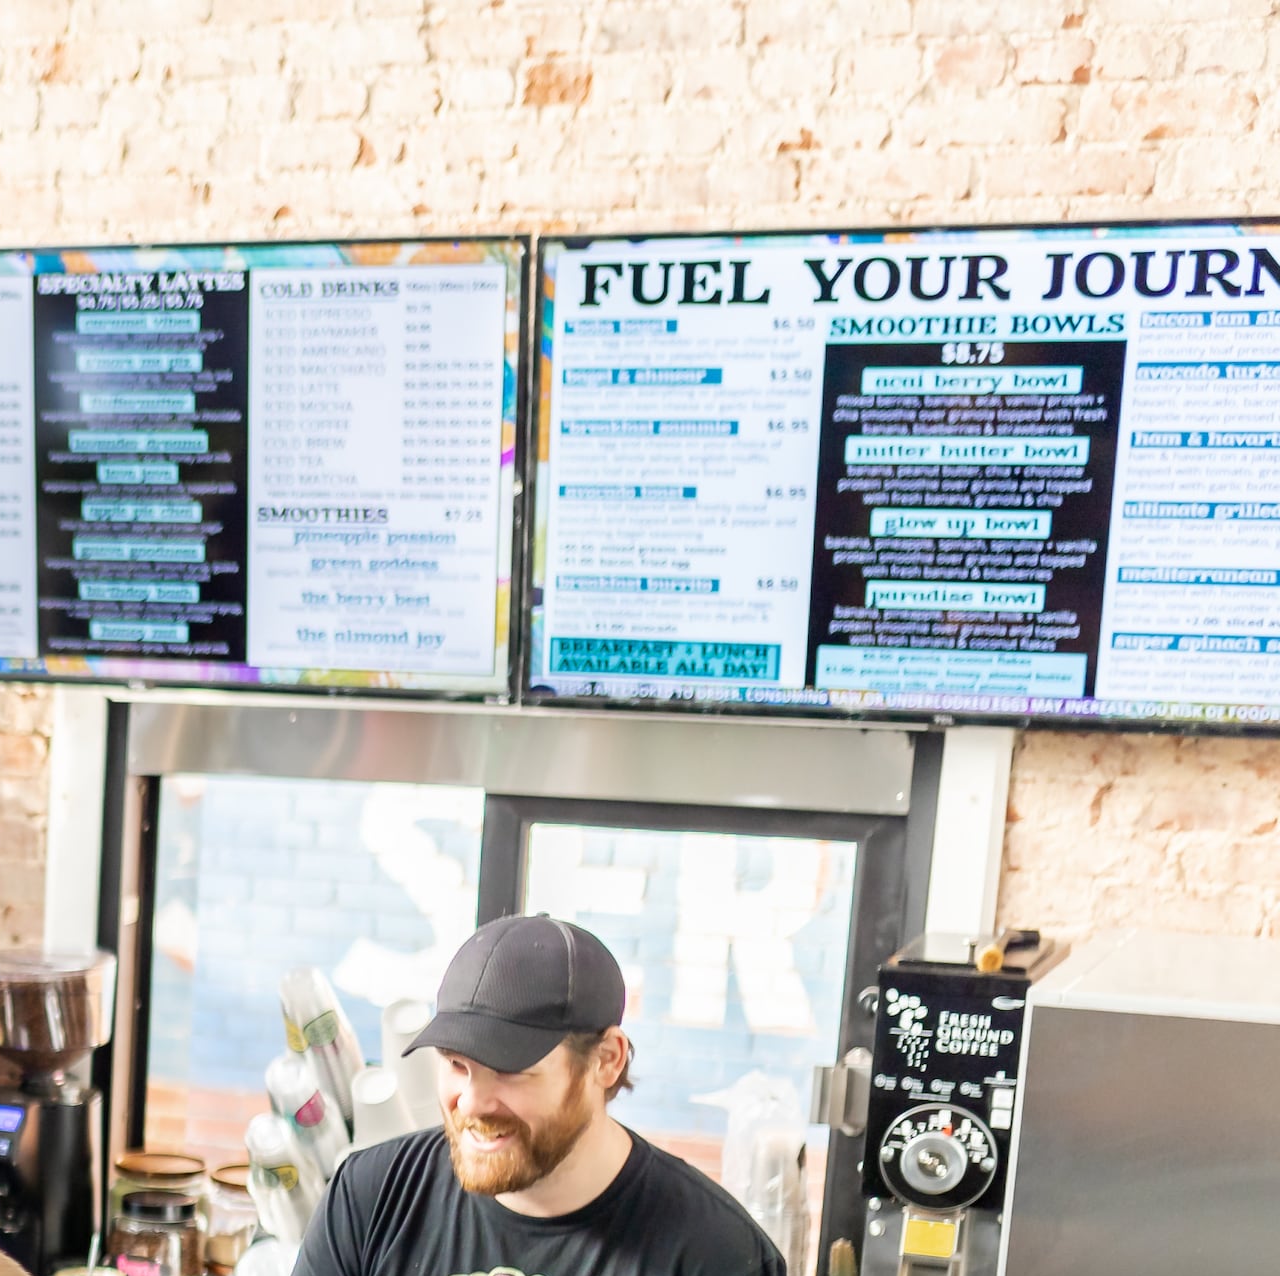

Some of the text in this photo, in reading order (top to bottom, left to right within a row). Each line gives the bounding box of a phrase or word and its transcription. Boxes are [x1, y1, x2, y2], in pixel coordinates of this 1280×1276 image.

[40, 273, 154, 295] SPECIALTY
[159, 271, 244, 291] LATTES
[260, 282, 312, 298] COLD
[322, 280, 400, 297] DRINKS
[579, 260, 771, 307] FUEL
[804, 253, 1012, 304] YOUR
[773, 318, 815, 329] $6.50
[830, 312, 1125, 337] SMOOTHIE BOWLS
[941, 342, 1005, 365] $8.75
[1137, 363, 1220, 379] avocado
[935, 374, 1004, 396] berry
[1013, 373, 1069, 388] bowl
[1135, 431, 1181, 447] ham
[856, 443, 1079, 459] nutter butter bowl
[257, 507, 389, 523] SMOOTHIES
[1124, 502, 1210, 518] ultimate
[294, 528, 456, 546] pineapple passion
[885, 516, 1040, 539] glow up bowl
[311, 558, 438, 573] green goddess
[1120, 567, 1277, 584] mediterranean
[302, 592, 329, 605] the
[871, 588, 1038, 608] paradise bowl
[297, 628, 446, 649] the almond joy
[1114, 634, 1260, 653] super spinach
[559, 640, 678, 659] BREAKFAST
[701, 644, 768, 660] LUNCH
[558, 657, 768, 679] AVAILABLE ALL DAY!
[746, 688, 829, 705] CONSUMING
[887, 693, 989, 711] UNDERCOOKED
[1031, 697, 1064, 714] MAY
[1066, 698, 1135, 717] INCREASE
[1140, 702, 1167, 717] YOU
[1170, 703, 1203, 718] RISK
[1206, 705, 1226, 719] OF
[939, 1010, 993, 1029] FRESH
[936, 1025, 1014, 1046] GROUND
[935, 1039, 999, 1057] COFFEE
